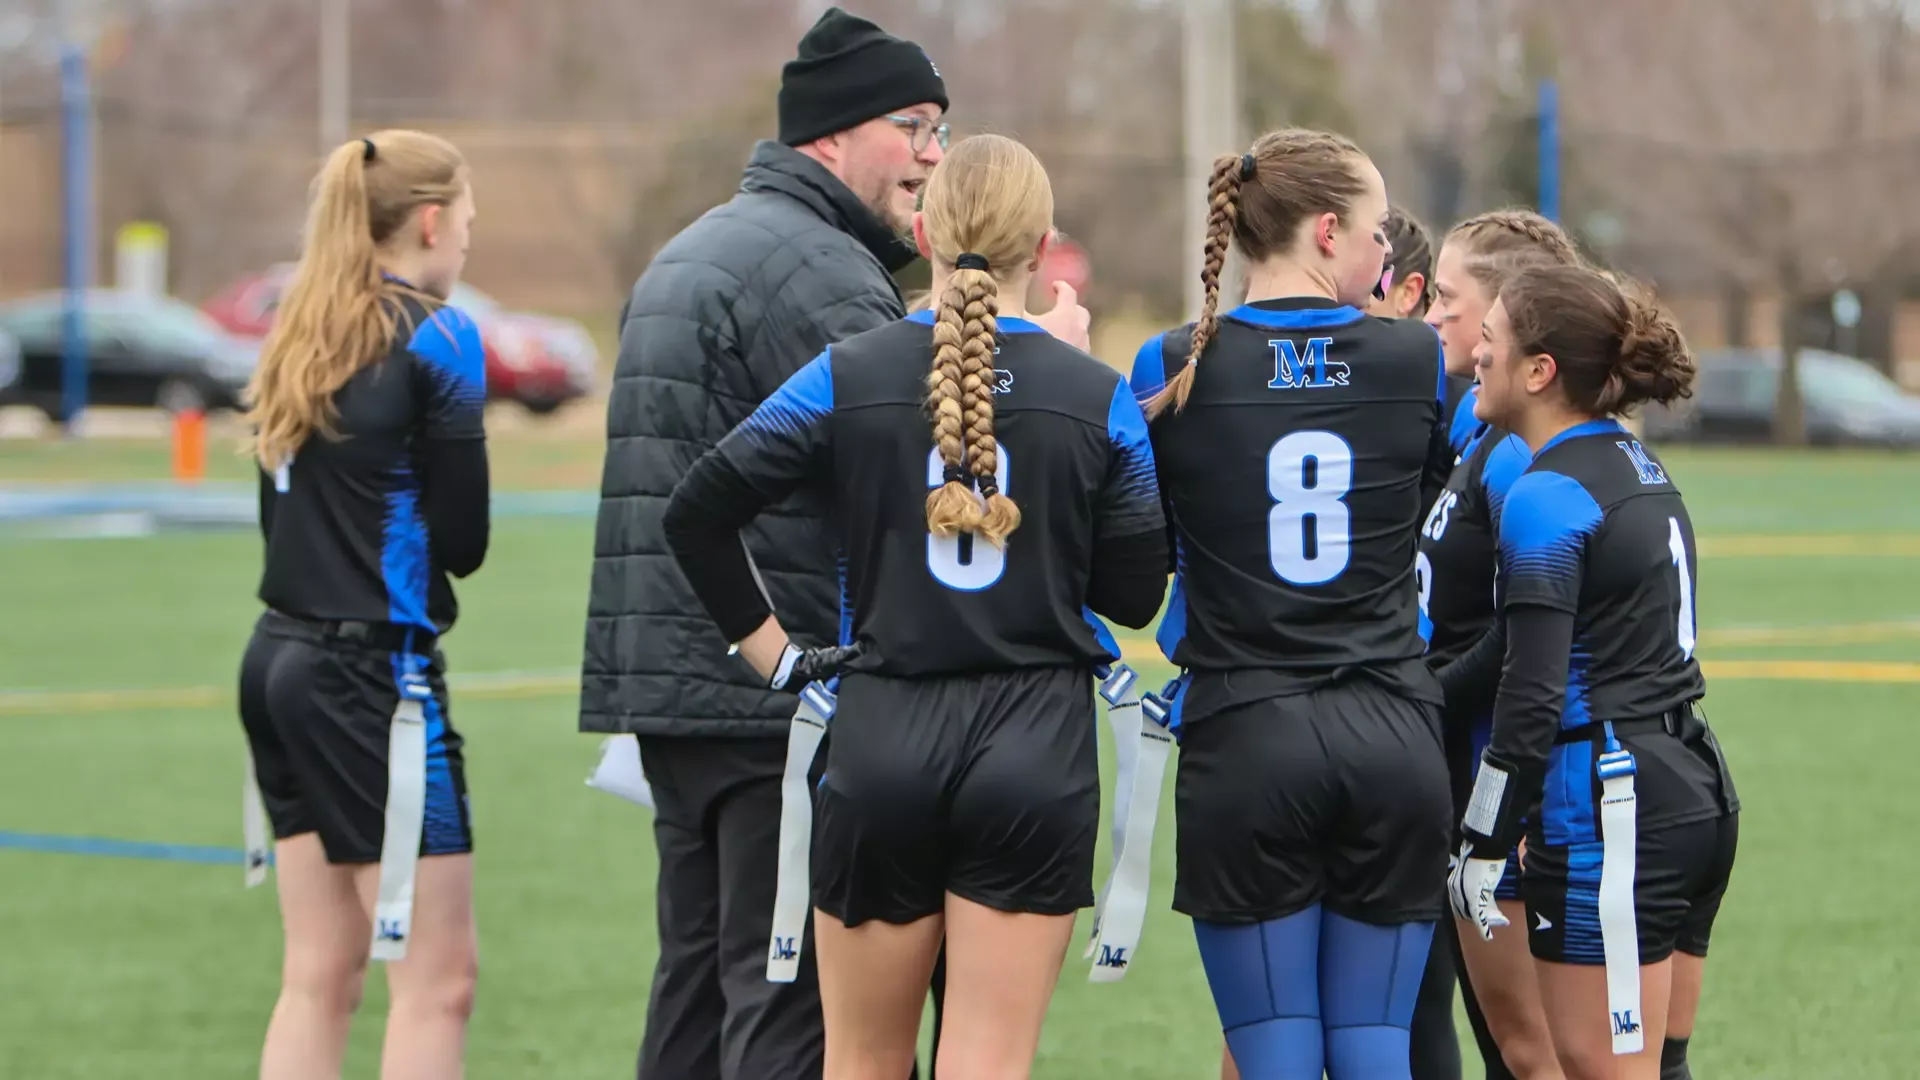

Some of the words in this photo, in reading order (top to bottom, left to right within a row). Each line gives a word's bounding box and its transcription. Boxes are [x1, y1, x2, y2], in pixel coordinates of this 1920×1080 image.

[1267, 429, 1354, 586] 8
[1668, 516, 1695, 662] 1
[1611, 1009, 1636, 1035] M
